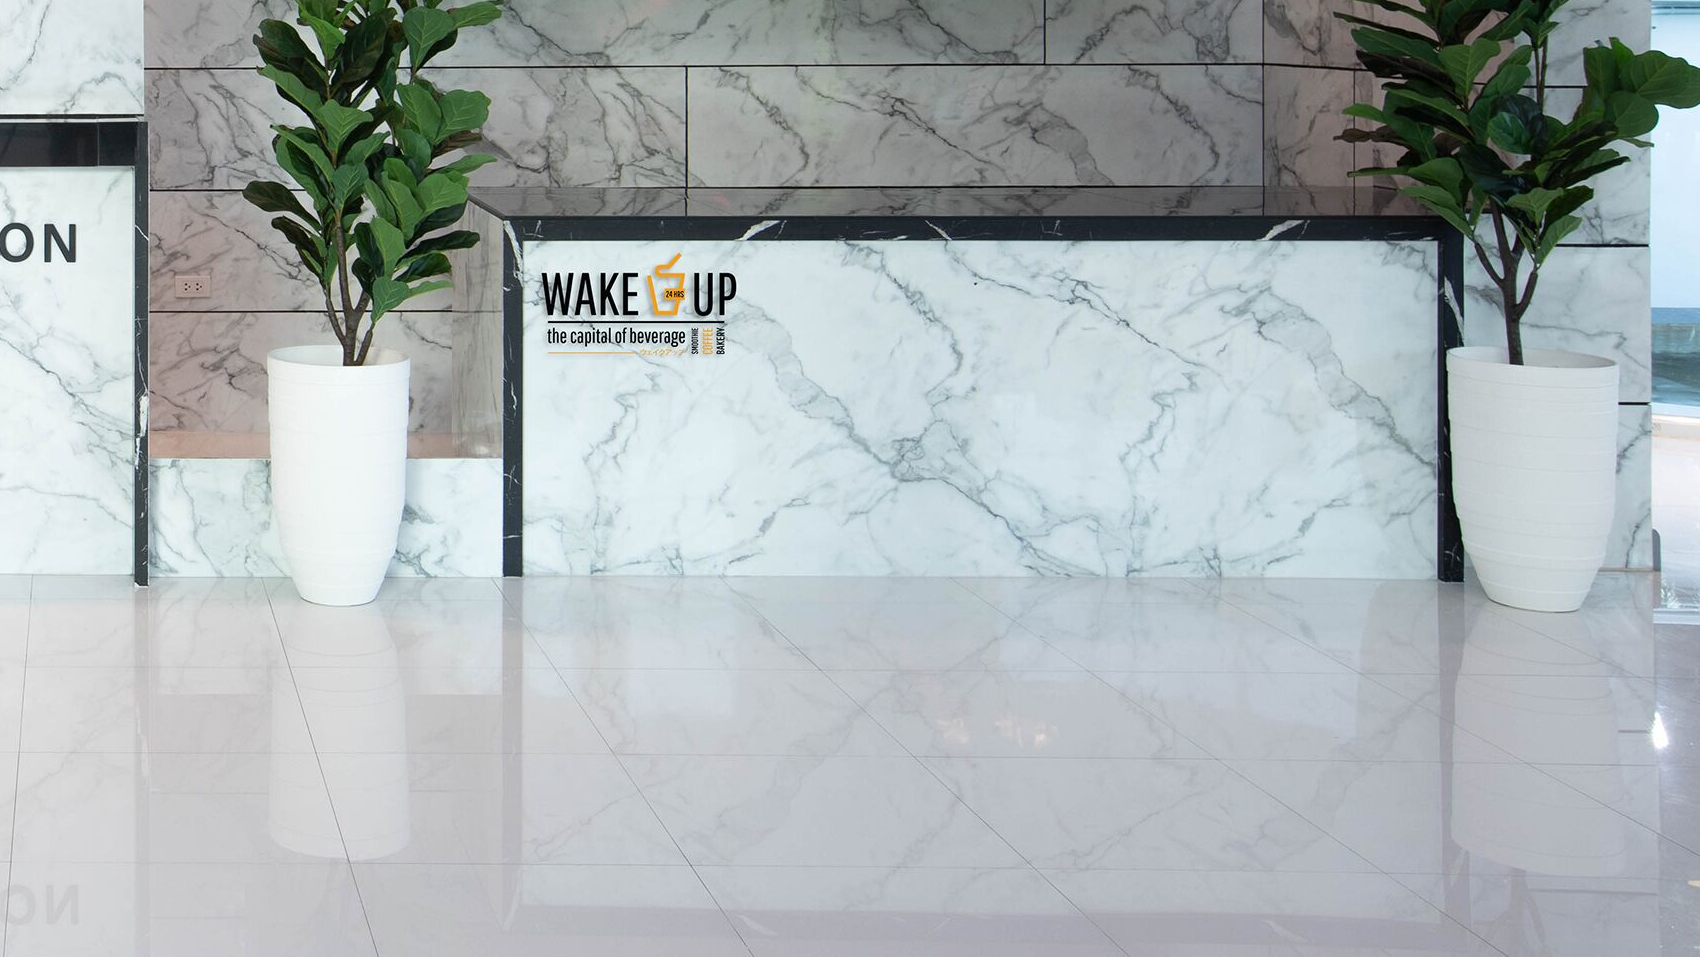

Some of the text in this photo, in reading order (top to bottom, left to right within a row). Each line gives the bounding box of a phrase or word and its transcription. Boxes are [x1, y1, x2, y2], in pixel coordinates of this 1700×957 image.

[541, 272, 737, 317] WAKE UP
[665, 290, 685, 298] 24 HRS
[547, 327, 686, 347] the capital of beverage
[691, 328, 699, 355] SMOOTHIE
[702, 328, 713, 355] COFFEE
[716, 327, 725, 355] BAKERY
